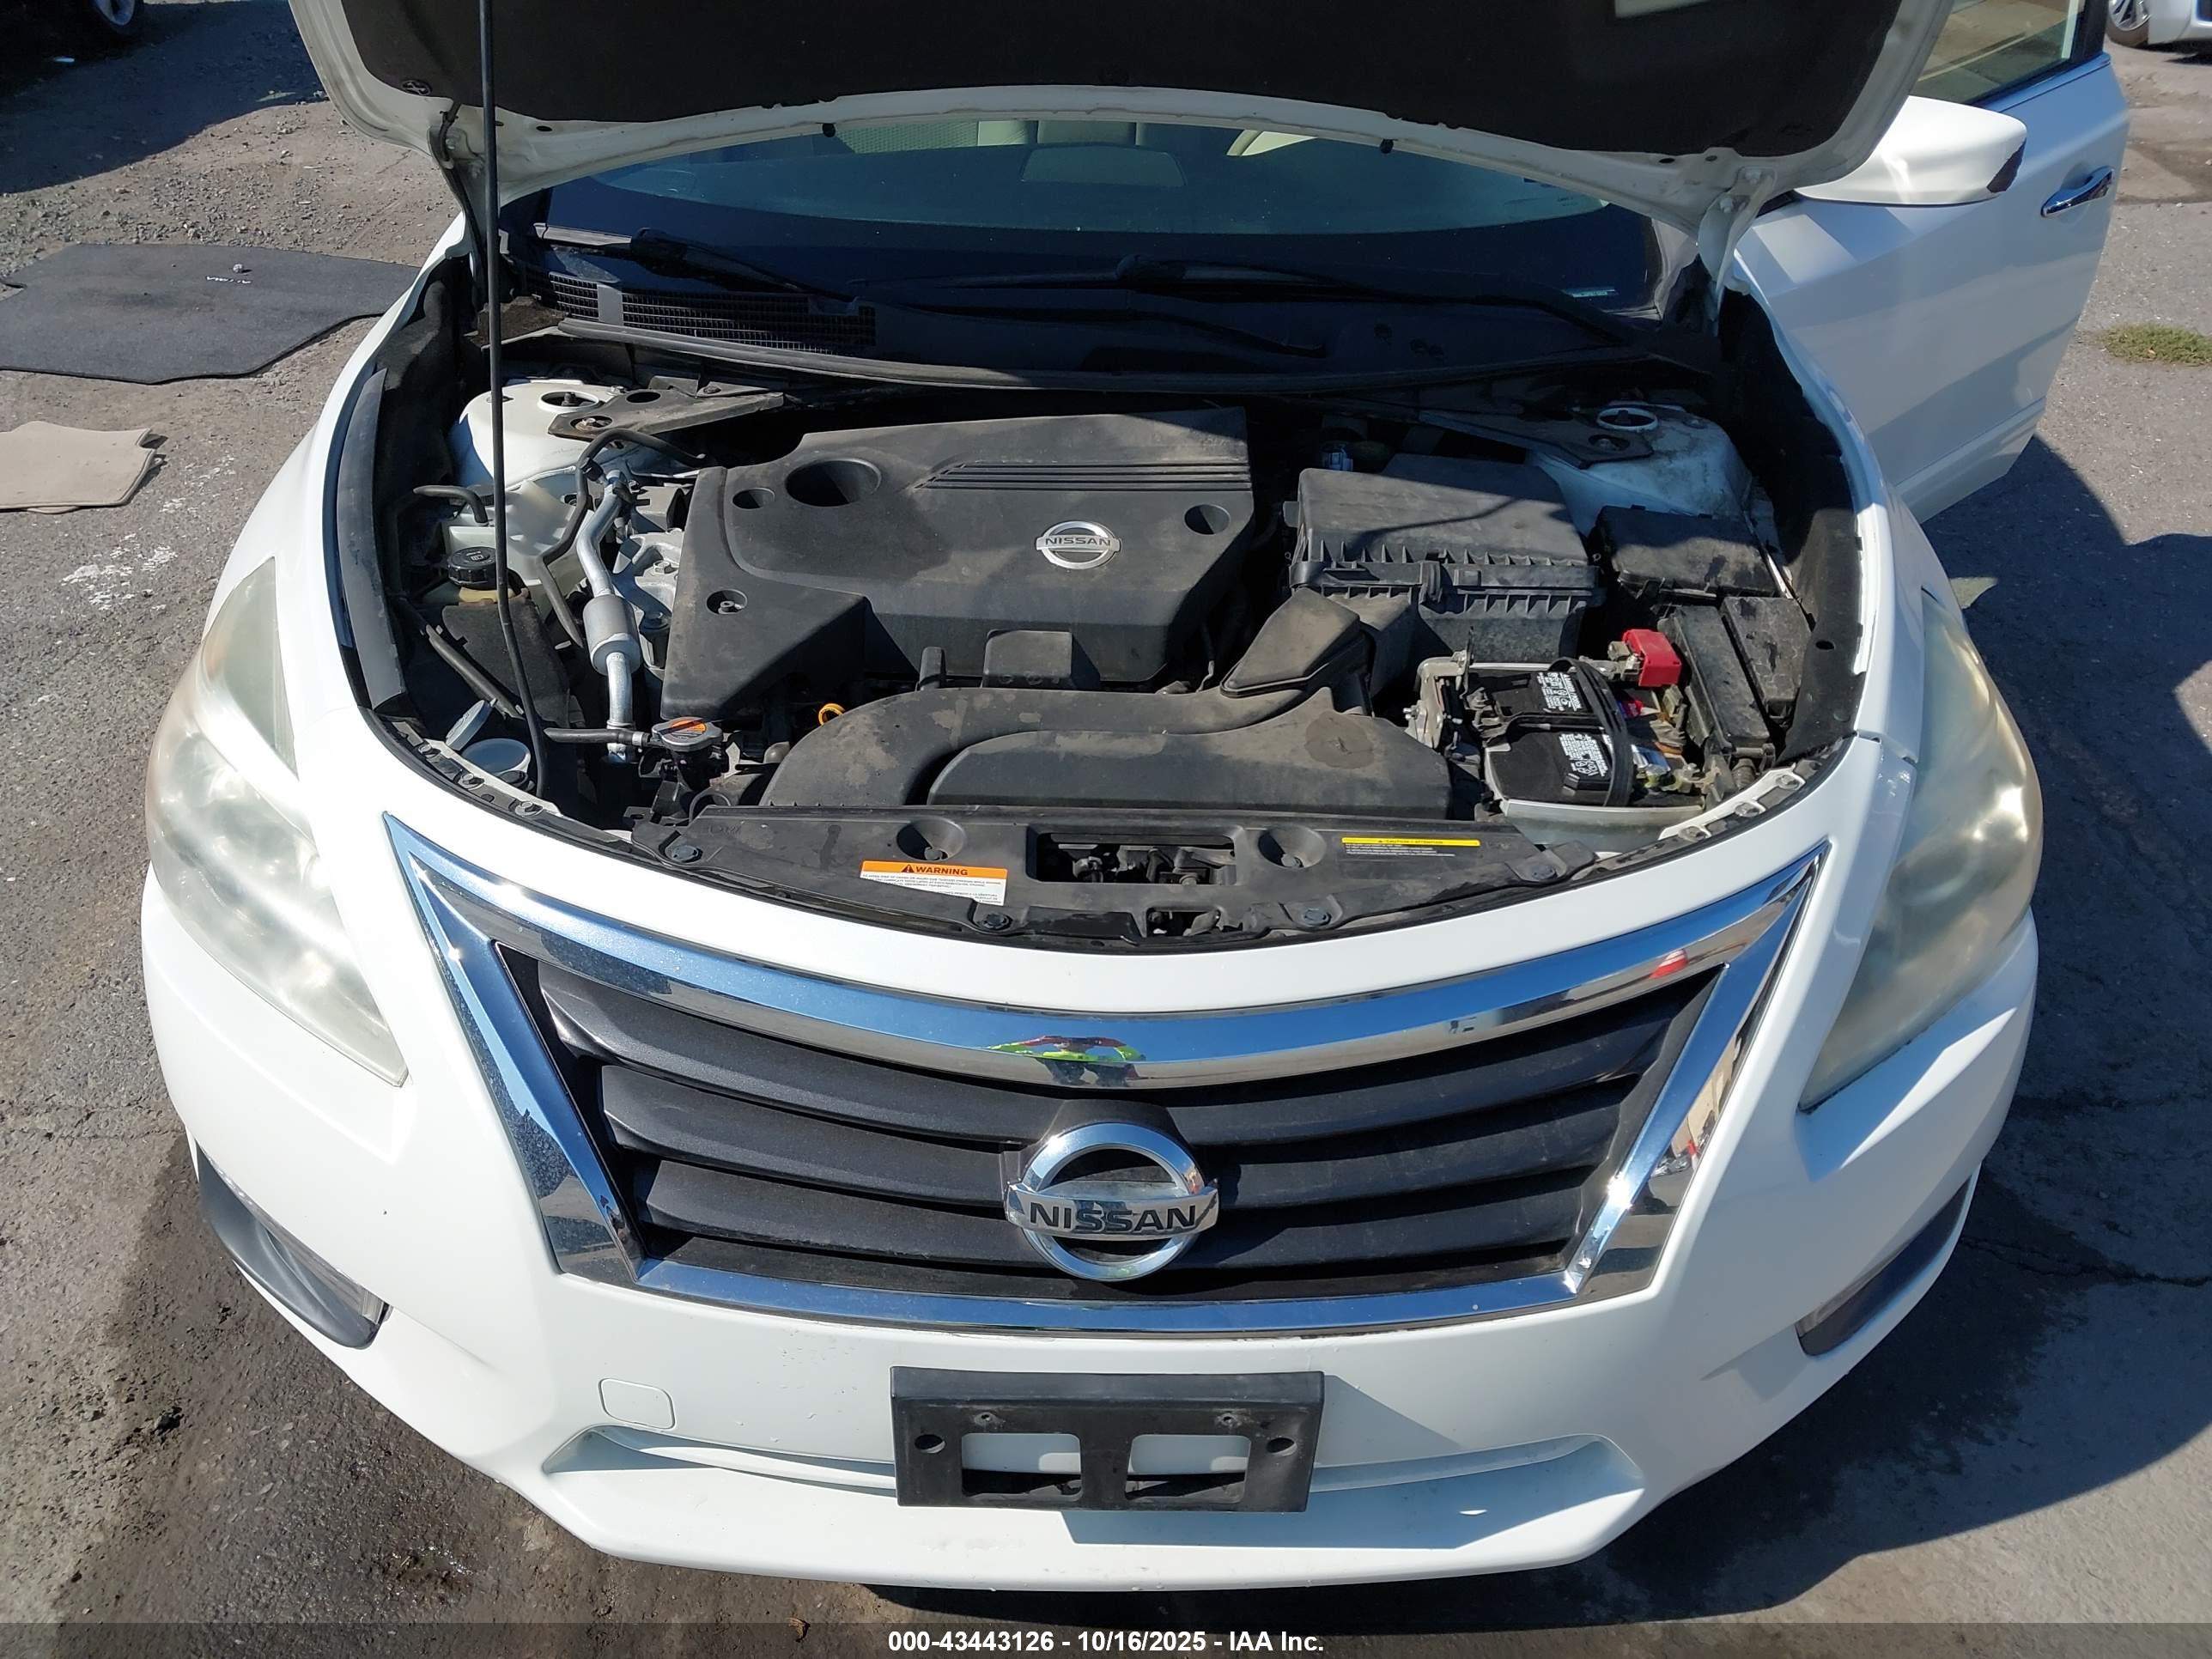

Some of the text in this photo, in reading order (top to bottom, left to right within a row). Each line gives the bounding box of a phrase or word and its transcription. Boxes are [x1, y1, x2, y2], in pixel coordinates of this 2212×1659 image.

[1045, 537, 1111, 546] NISSAN
[915, 866, 969, 875] WARNING
[1030, 1201, 1196, 1233] NISSAN
